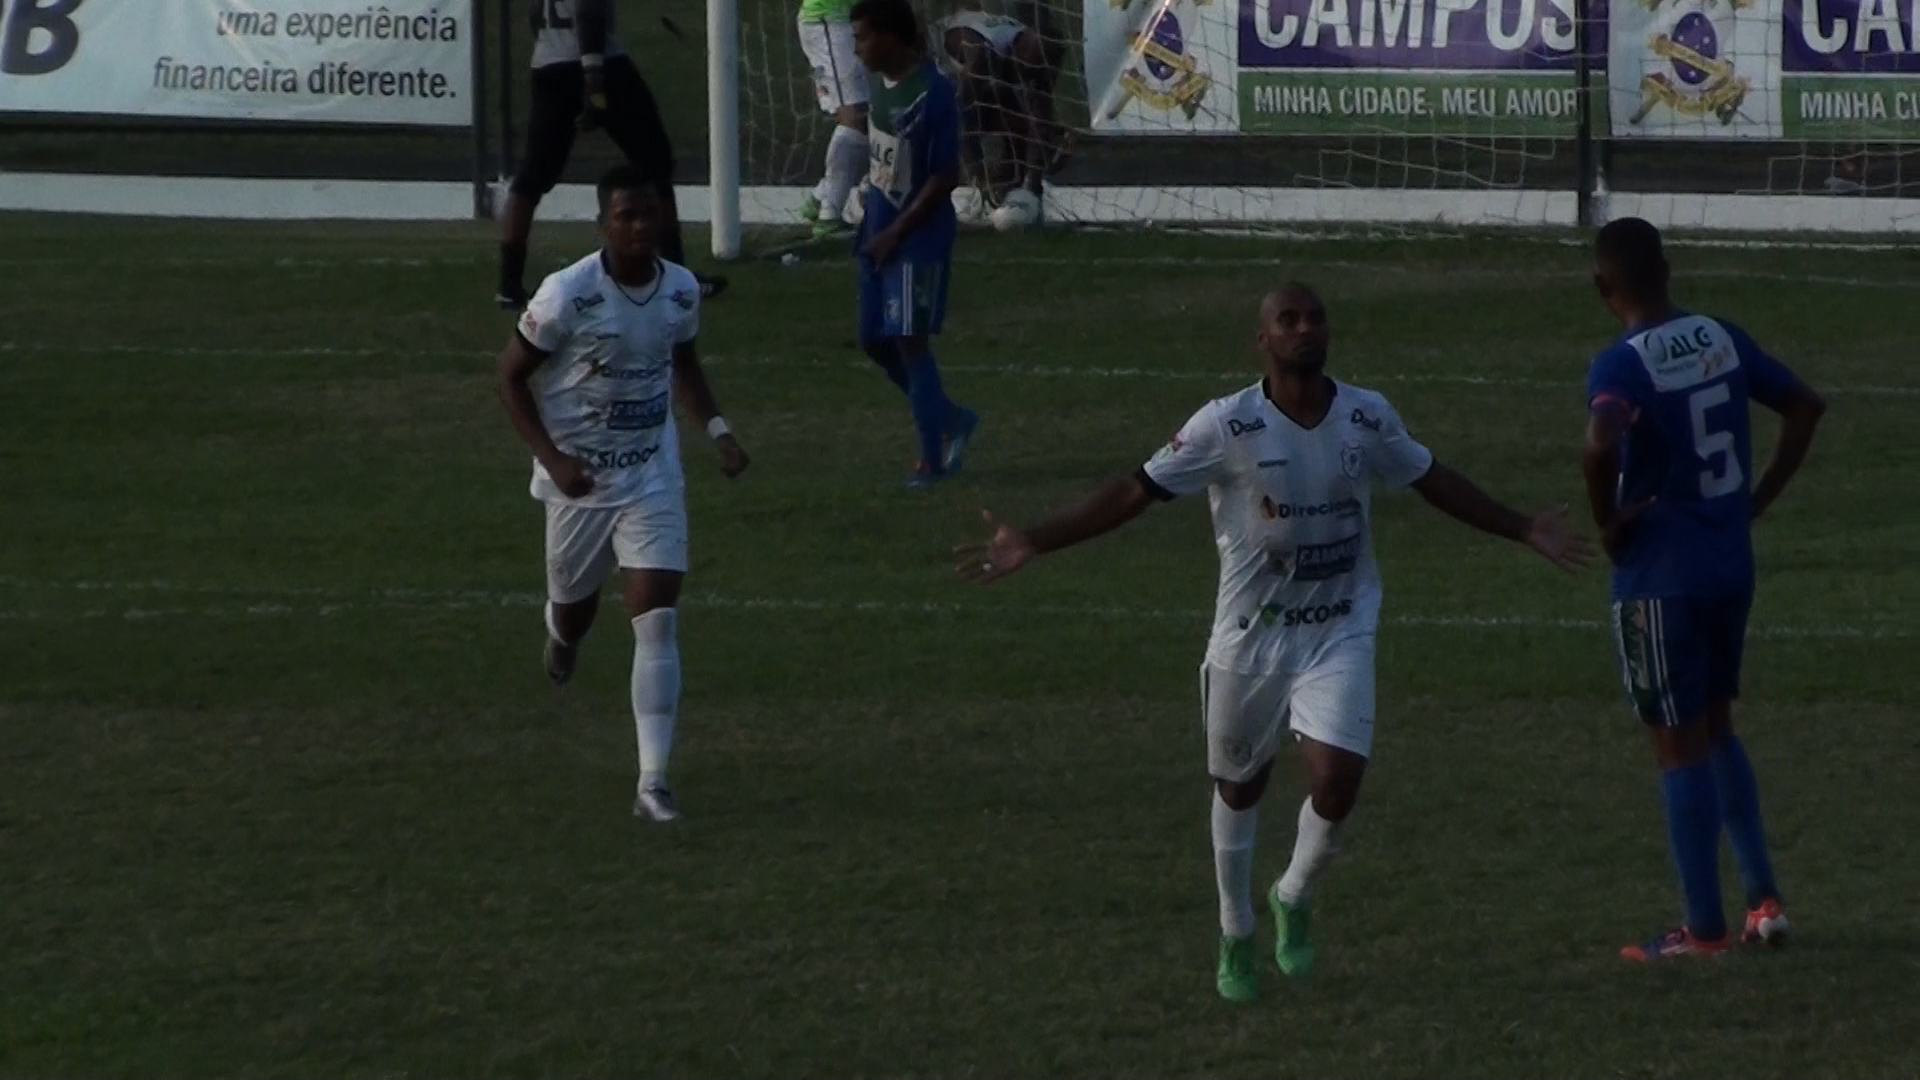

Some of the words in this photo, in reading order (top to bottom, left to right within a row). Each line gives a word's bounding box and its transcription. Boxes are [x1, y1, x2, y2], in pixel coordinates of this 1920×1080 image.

[217, 10, 276, 37] uma
[286, 6, 457, 44] experiência
[153, 56, 298, 94] financeira
[308, 62, 457, 99] diferente.
[1254, 86, 1330, 115] MINHA
[1339, 87, 1434, 117] CIDADE,
[1442, 87, 1497, 117] MEU
[1505, 87, 1577, 117] AMOR
[1801, 91, 1888, 120] MINHA
[1689, 381, 1744, 499] 5
